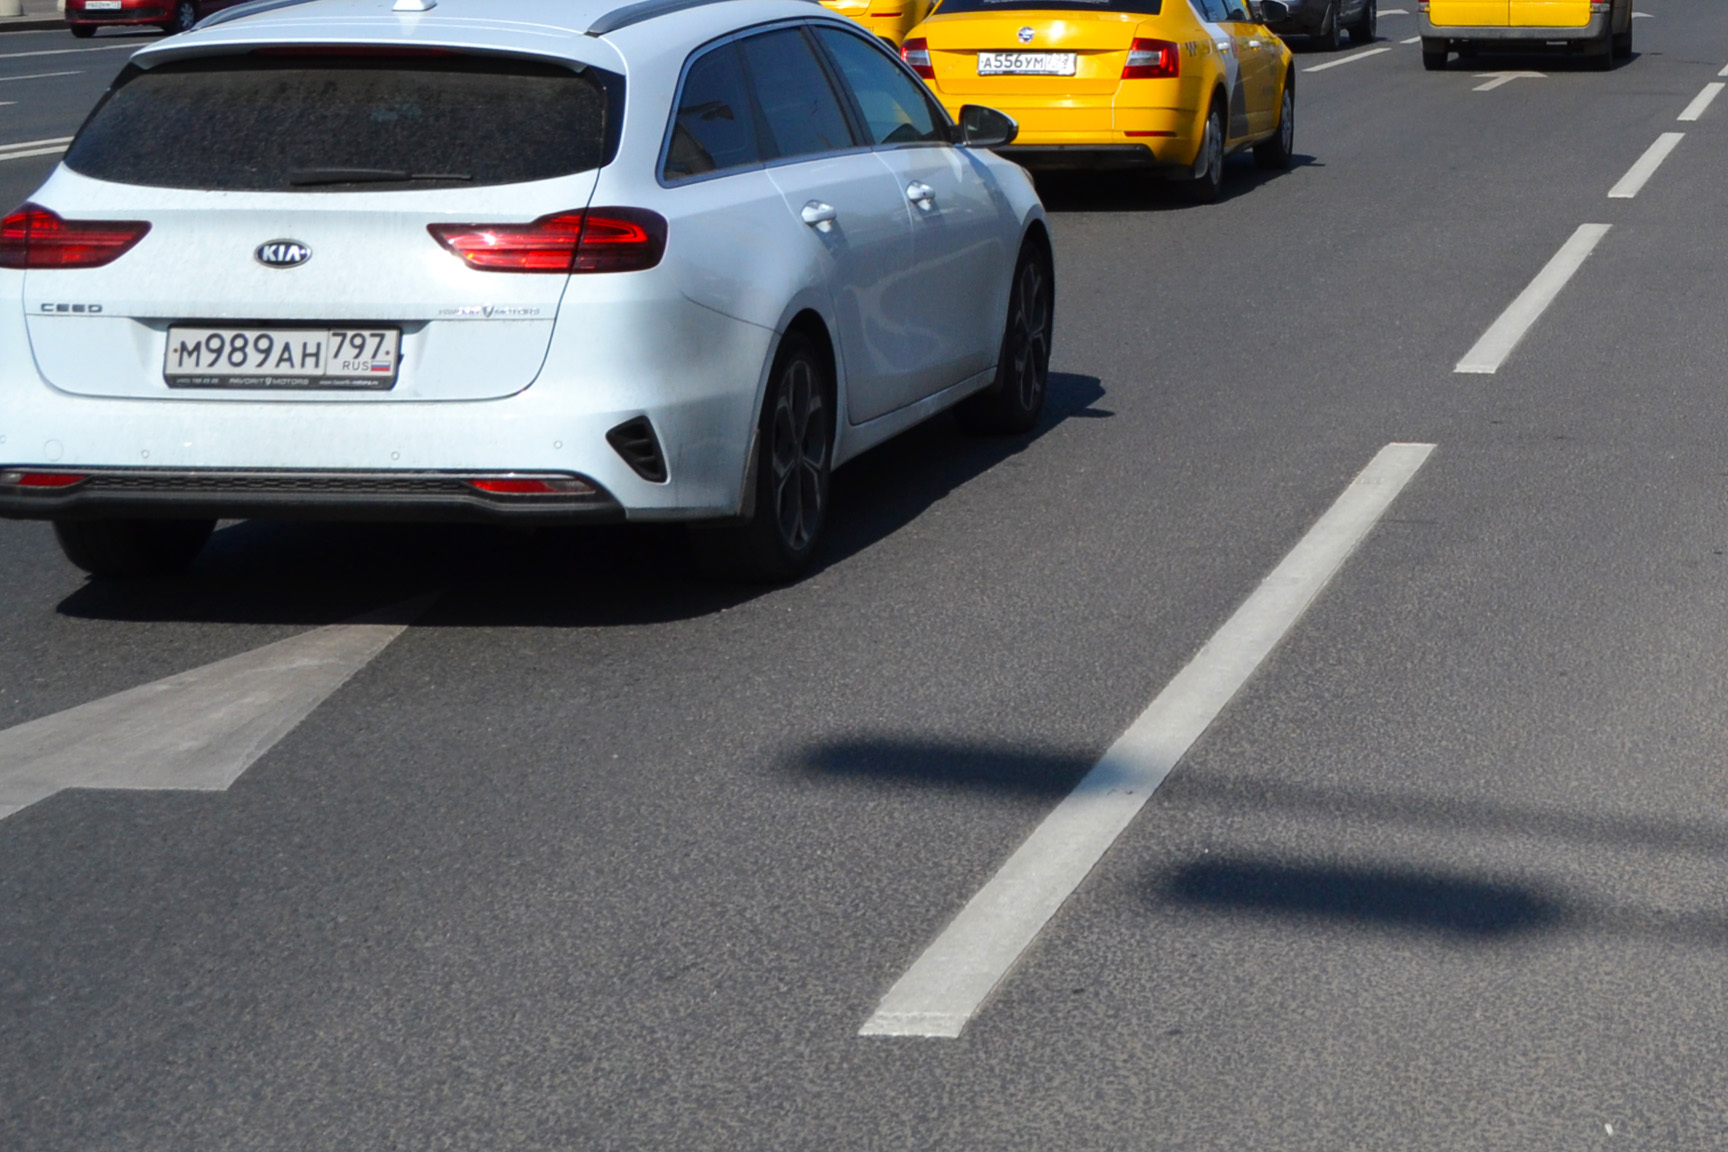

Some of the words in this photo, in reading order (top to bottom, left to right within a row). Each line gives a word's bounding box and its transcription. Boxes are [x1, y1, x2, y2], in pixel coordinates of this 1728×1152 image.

[262, 246, 301, 262] KIA
[41, 303, 103, 313] CEED
[331, 332, 386, 360] 797
[342, 361, 370, 371] RUS
[272, 378, 309, 386] MOTORS
